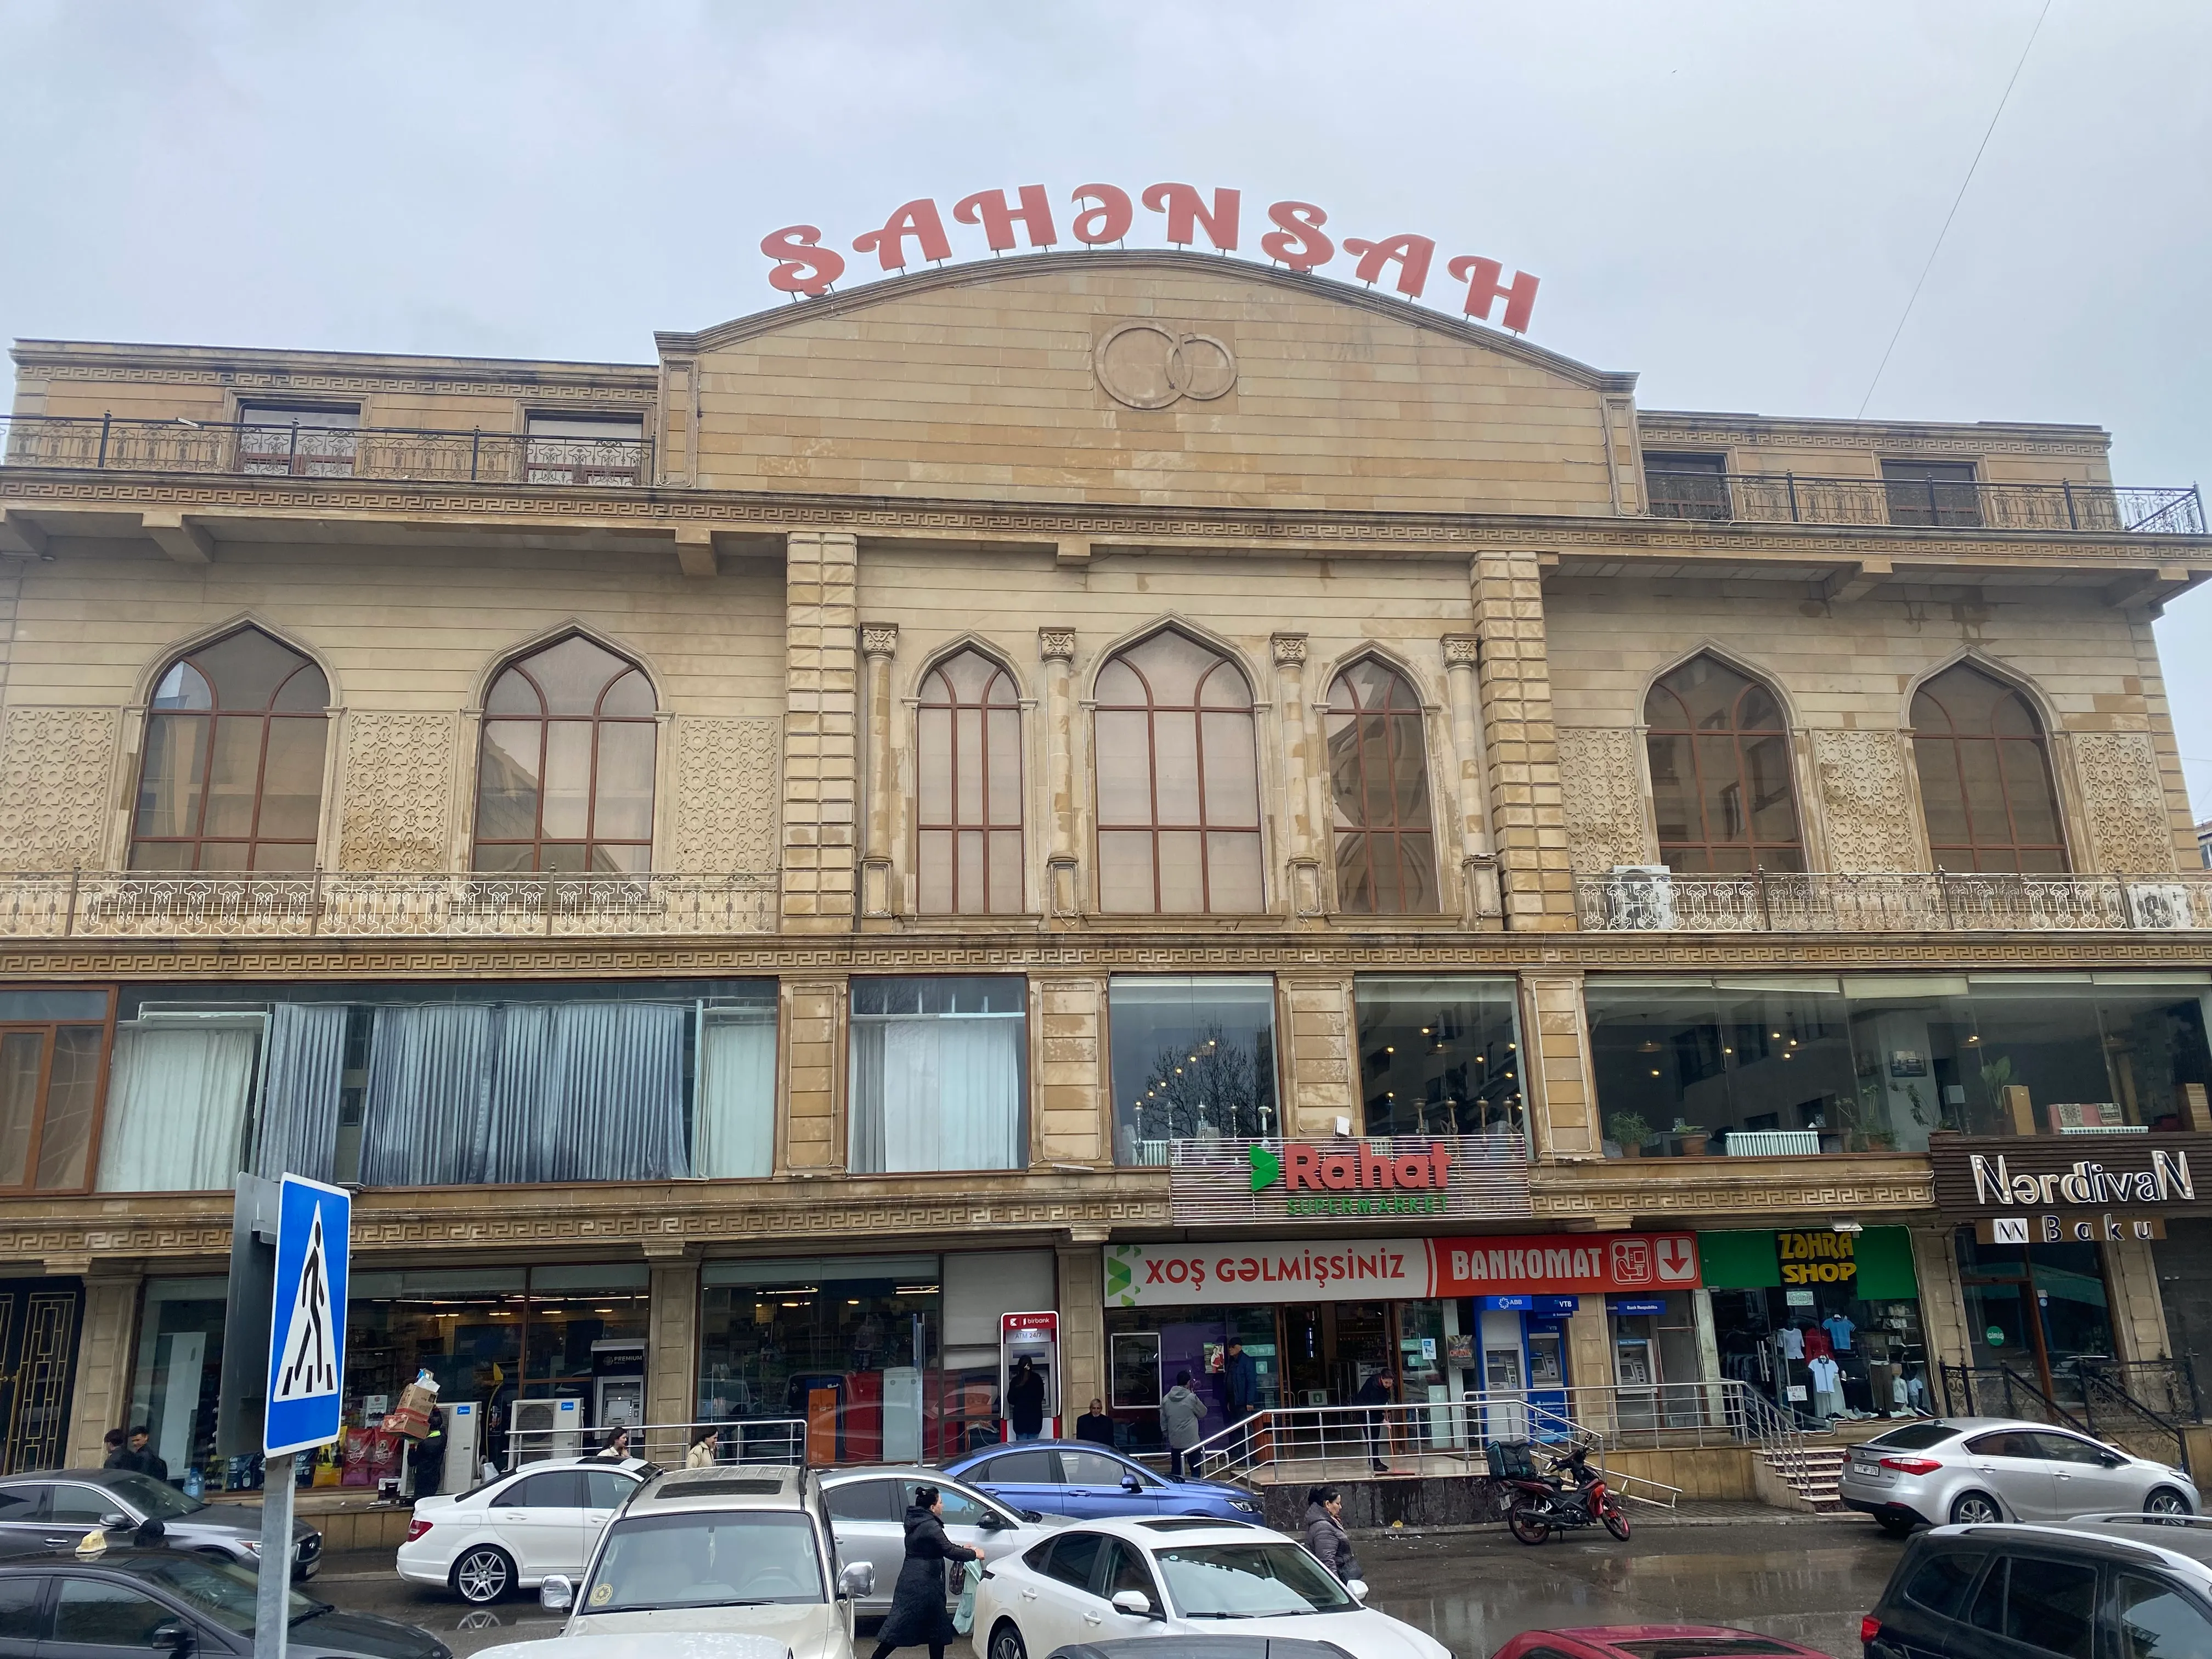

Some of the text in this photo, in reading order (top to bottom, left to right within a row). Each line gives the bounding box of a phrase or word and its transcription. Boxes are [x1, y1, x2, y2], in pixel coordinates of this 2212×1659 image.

[1284, 1143, 1452, 1190] Rahat
[1287, 1196, 1448, 1215] SUPERMARKET
[2042, 1214, 2154, 1243] Baku
[1146, 1248, 1405, 1291] XOŞ GƏLMİŞSİNİZ
[1452, 1248, 1602, 1280] BANKOMAT
[1782, 1263, 1857, 1284] SHOP
